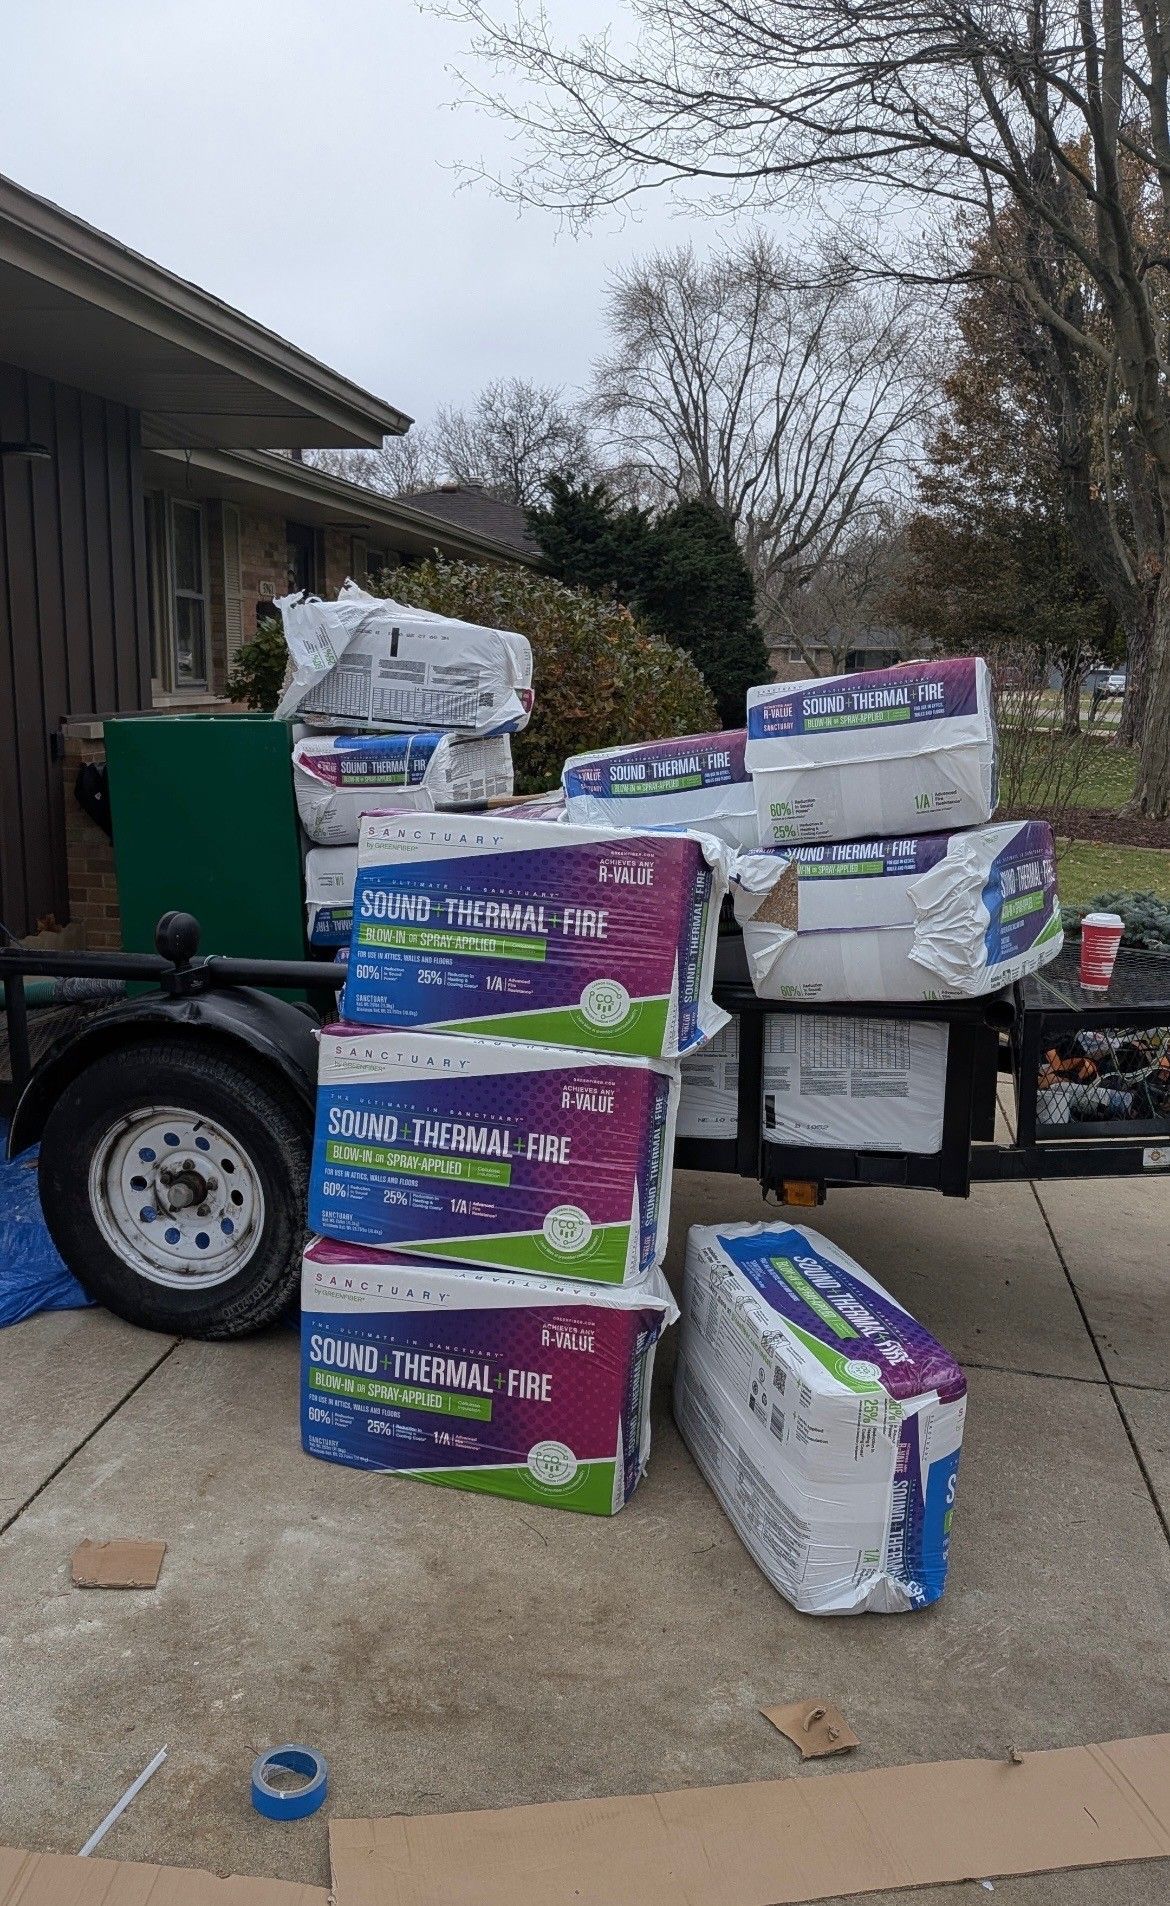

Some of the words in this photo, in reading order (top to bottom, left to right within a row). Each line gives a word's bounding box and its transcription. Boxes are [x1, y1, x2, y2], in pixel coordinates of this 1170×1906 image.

[763, 709, 793, 720] R-VALUE
[915, 793, 931, 810] 1/A
[599, 858, 636, 867] ACHIEVES
[598, 867, 654, 887] R-VALUE
[364, 927, 406, 944] BLOW-IN
[420, 933, 497, 952] SPRAY-APPLIED
[356, 964, 380, 980] 60%
[417, 969, 443, 985] 25%
[485, 976, 502, 991] 1/A
[562, 1084, 598, 1094] ACHIEVES
[599, 1087, 615, 1096] ANY
[561, 1091, 615, 1114] R-VALUE
[332, 1144, 373, 1164] BLOW-IN
[386, 1152, 462, 1175] SPRAY-APPLIED
[322, 1181, 346, 1198] 60%
[383, 1189, 408, 1206] 25%
[450, 1198, 467, 1215] 1/A
[542, 1323, 579, 1333] ACHIEVES
[541, 1329, 595, 1353] R-VALUE
[314, 1371, 355, 1393] BLOW-IN
[367, 1382, 443, 1409] SPRAY-APPLIED
[308, 1406, 331, 1425] 60%
[863, 1399, 878, 1424] 25%
[366, 1419, 391, 1436] 25%
[433, 1431, 450, 1446] 1/A
